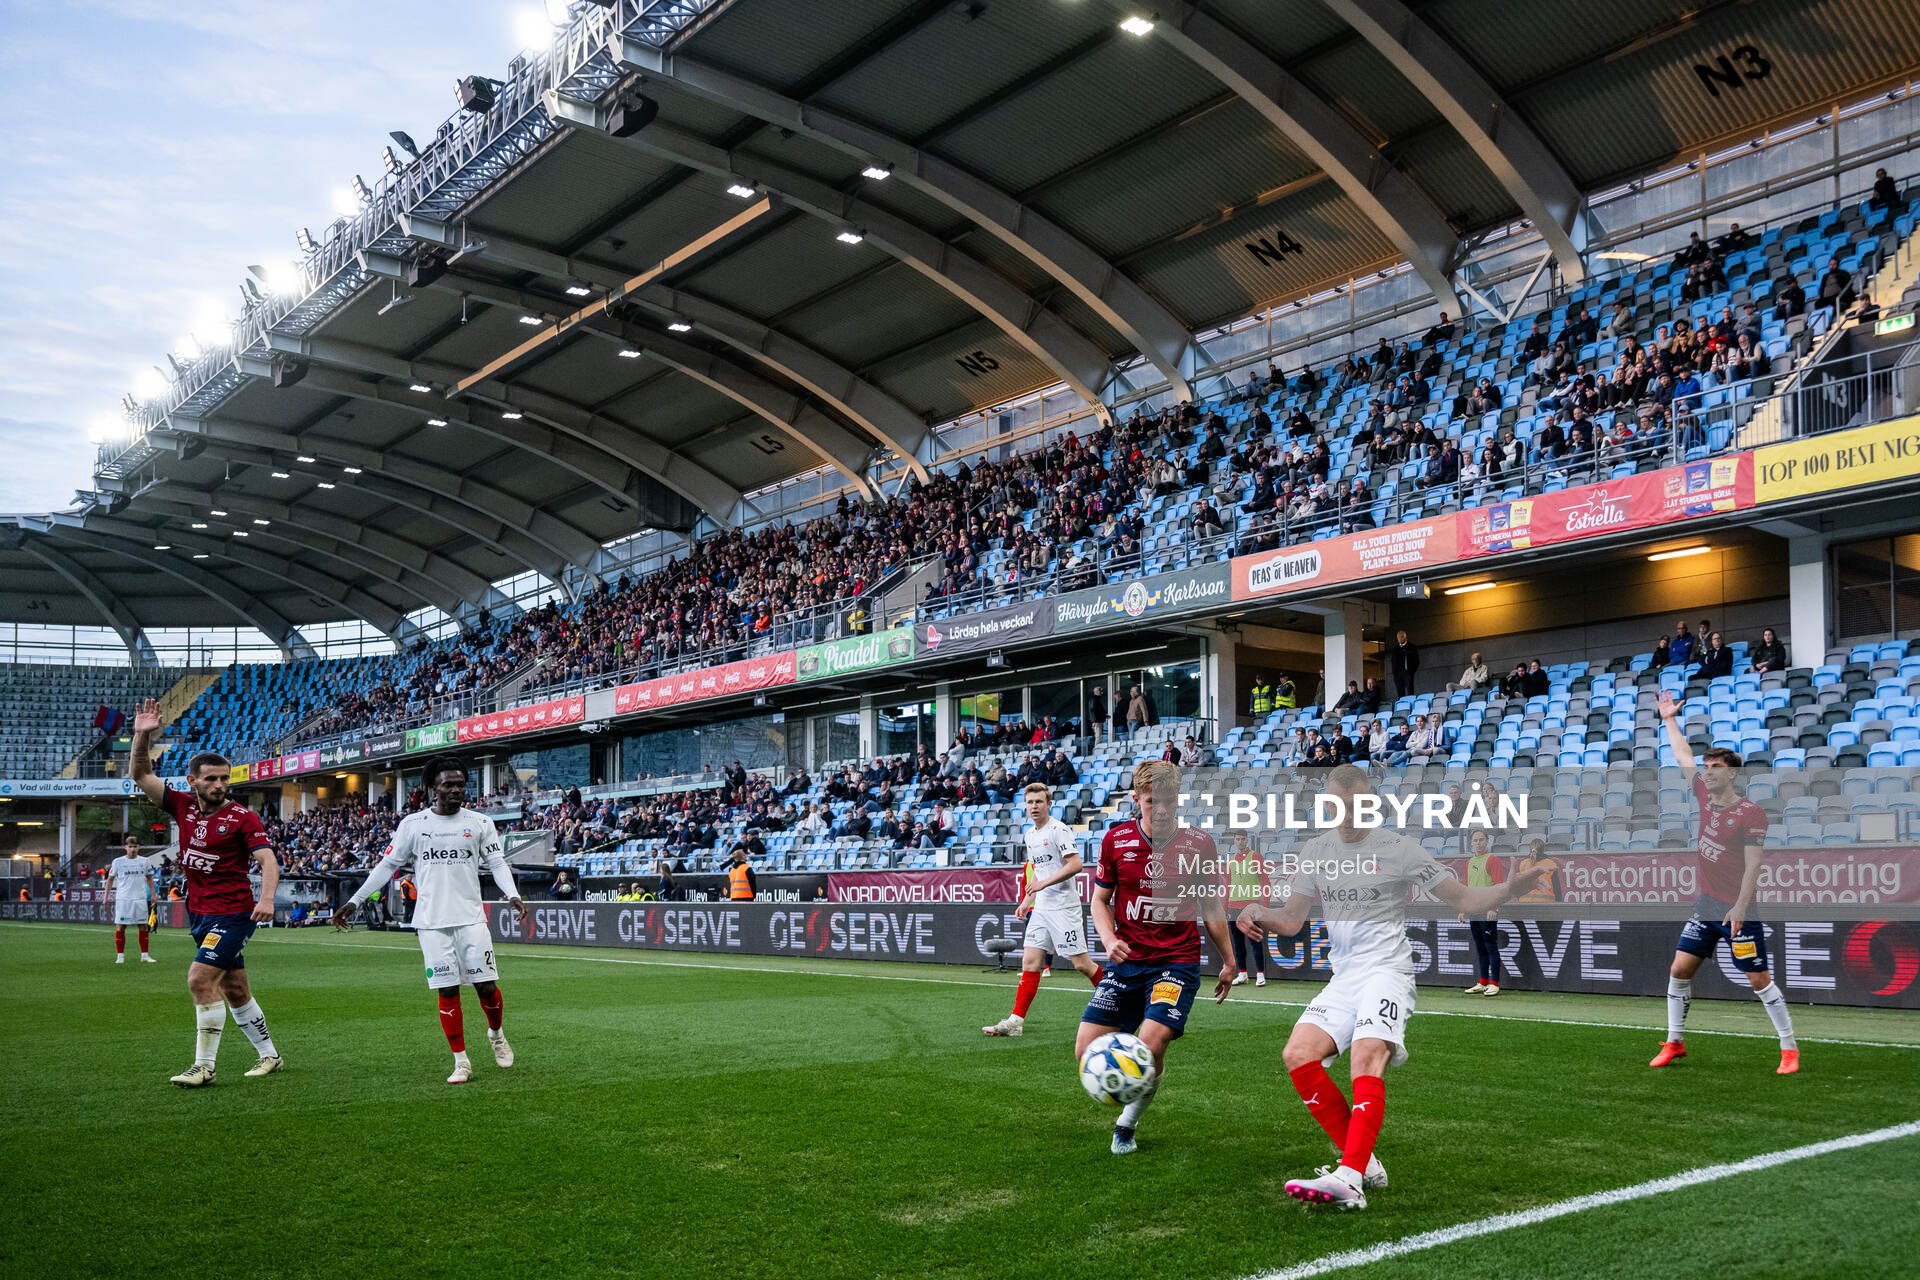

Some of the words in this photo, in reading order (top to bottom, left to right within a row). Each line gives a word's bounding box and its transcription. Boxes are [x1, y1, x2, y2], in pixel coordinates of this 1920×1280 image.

[1693, 45, 1772, 97] N3
[1244, 229, 1302, 267] N4
[956, 350, 1001, 377] N5
[749, 434, 785, 455] L5
[1760, 459, 1797, 484] TOP
[1804, 453, 1830, 476] 100
[1836, 443, 1877, 470] BEST
[1565, 504, 1625, 532] Estrella
[1352, 539, 1367, 551] ALL
[1369, 534, 1390, 547] YOUR
[1391, 526, 1434, 544] FAVORITE
[1359, 548, 1384, 561] FOODS
[1385, 544, 1404, 557] ARE
[1404, 539, 1426, 553] NOW
[1252, 566, 1271, 585] PEAS
[1284, 555, 1317, 579] HEAVEN
[1362, 554, 1423, 571] PLANT-BASED.
[1058, 599, 1109, 625] Härryda
[1163, 579, 1226, 606] Karlsson
[1405, 586, 1417, 596] M3
[949, 624, 979, 641] Lördag
[980, 620, 999, 634] hela
[1000, 611, 1034, 630] veckan!
[824, 635, 880, 674] Picadeli
[422, 848, 458, 861] akea
[485, 843, 501, 854] XXL
[1416, 864, 1439, 884] XXL
[1563, 859, 1697, 894] factoring
[1757, 856, 1901, 896] actoring
[585, 890, 607, 902] Gamla
[685, 889, 707, 902] Ullevi
[754, 889, 772, 902] mla
[774, 889, 800, 902] Ullevi
[1322, 886, 1358, 902] akea
[1757, 890, 1879, 904] ruppen
[1126, 896, 1182, 921] NTEX
[1065, 930, 1077, 943] 23
[1379, 998, 1398, 1021] 20
